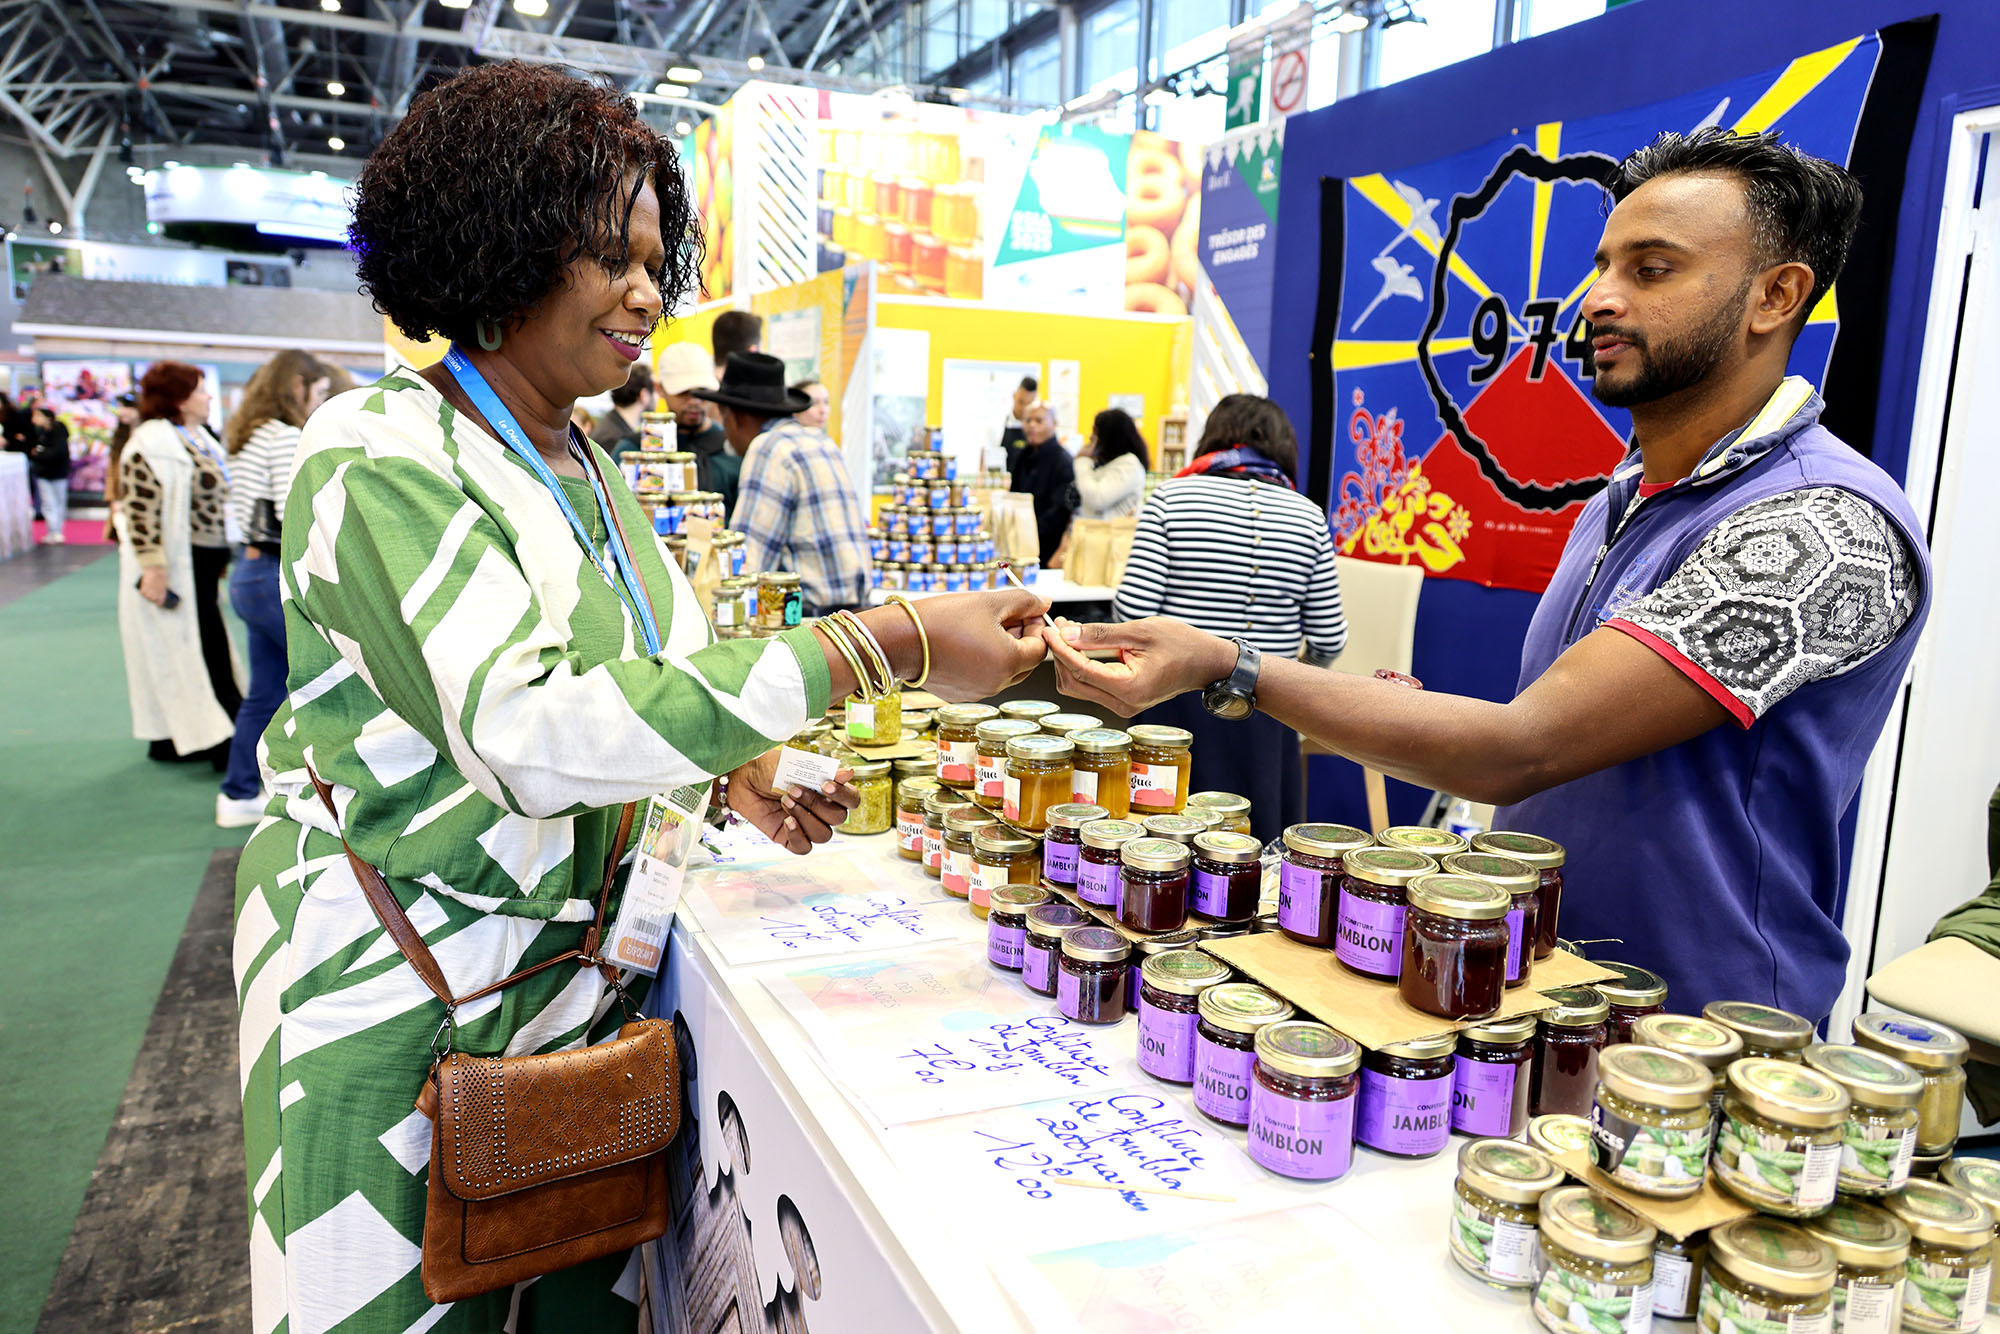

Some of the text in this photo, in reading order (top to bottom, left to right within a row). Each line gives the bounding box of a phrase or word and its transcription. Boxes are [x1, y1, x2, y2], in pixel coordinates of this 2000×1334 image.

[1470, 294, 1594, 385] 974
[1047, 859, 1079, 873] AMBLON
[1078, 876, 1108, 893] AMBLON
[1344, 915, 1374, 931] CONFITURE
[989, 940, 1024, 956] AMBLON
[1338, 922, 1393, 954] AMBLON
[989, 1023, 1025, 1040] de
[1026, 1016, 1109, 1077] Confiture
[1207, 1064, 1241, 1080] CONFITURE
[1198, 1071, 1248, 1101] AMBLO
[1068, 1100, 1102, 1123] de
[1392, 1109, 1450, 1132] JAMBLO
[1107, 1094, 1205, 1170] Confiture
